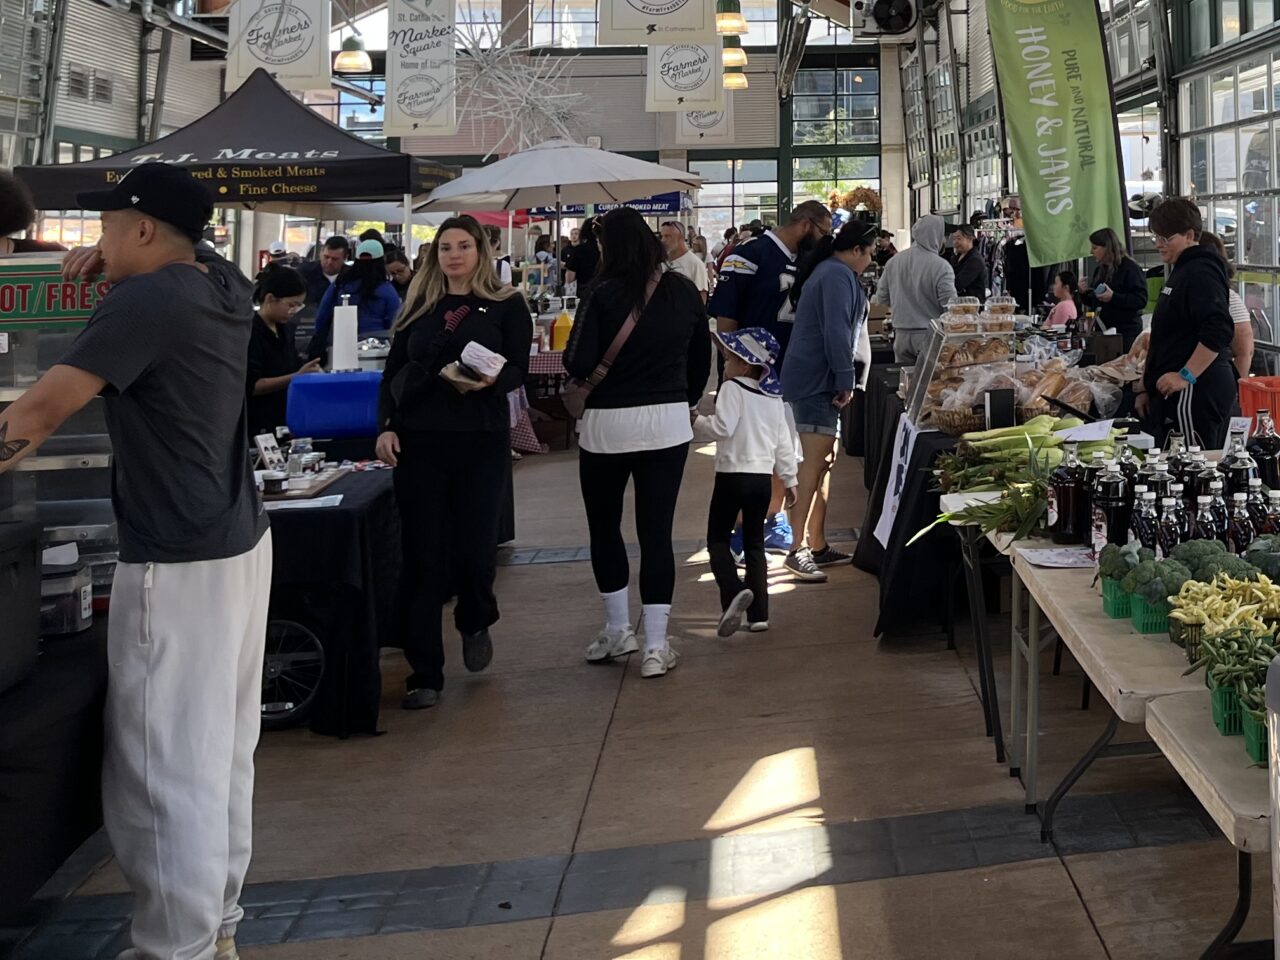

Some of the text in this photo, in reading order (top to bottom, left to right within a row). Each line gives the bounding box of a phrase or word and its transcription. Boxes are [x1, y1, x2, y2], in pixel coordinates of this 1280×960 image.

[400, 40, 442, 58] Square
[401, 61, 419, 69] Home
[661, 55, 708, 76] Farmers
[1061, 49, 1096, 171] PURE AND NATURAL
[1015, 25, 1073, 216] HONEY & JAMS
[212, 148, 340, 160] Meats
[217, 168, 228, 179] &
[232, 167, 283, 178] Smoked
[287, 166, 326, 177] Meats
[239, 183, 317, 195] Fine Cheese
